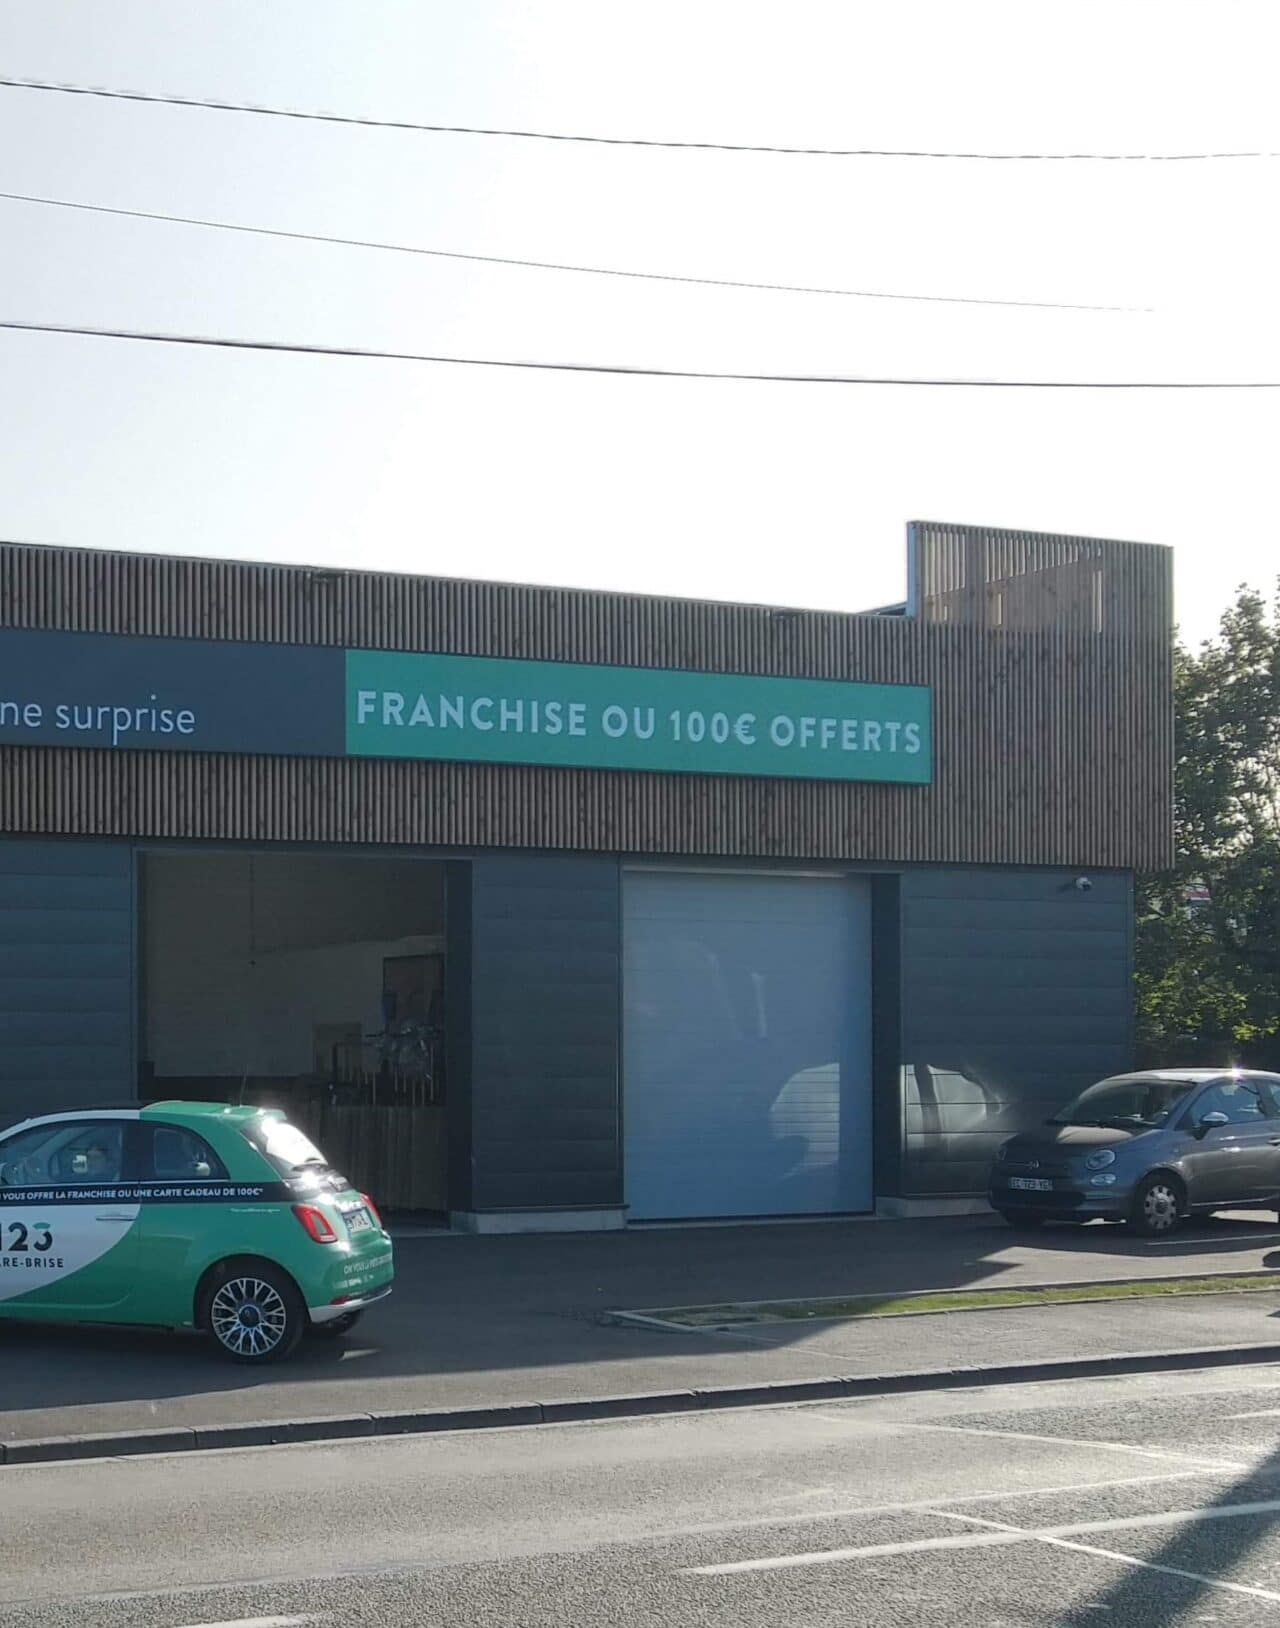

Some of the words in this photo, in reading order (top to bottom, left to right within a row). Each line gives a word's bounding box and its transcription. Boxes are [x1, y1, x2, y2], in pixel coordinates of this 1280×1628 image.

[55, 694, 196, 746] surprise
[357, 690, 586, 736] FRANCHISE
[601, 704, 655, 741] OU
[669, 709, 757, 746] 100€
[769, 713, 921, 755] OFFERTS
[3, 1192, 25, 1200] VOUS
[27, 1191, 53, 1199] OFFRE
[56, 1190, 66, 1199] LA
[67, 1190, 116, 1199] FRANCHISE
[118, 1189, 131, 1198] OU
[133, 1189, 152, 1197] UNE
[153, 1188, 182, 1197] CARTE
[183, 1187, 221, 1196] CADEAU
[222, 1187, 235, 1196] DE
